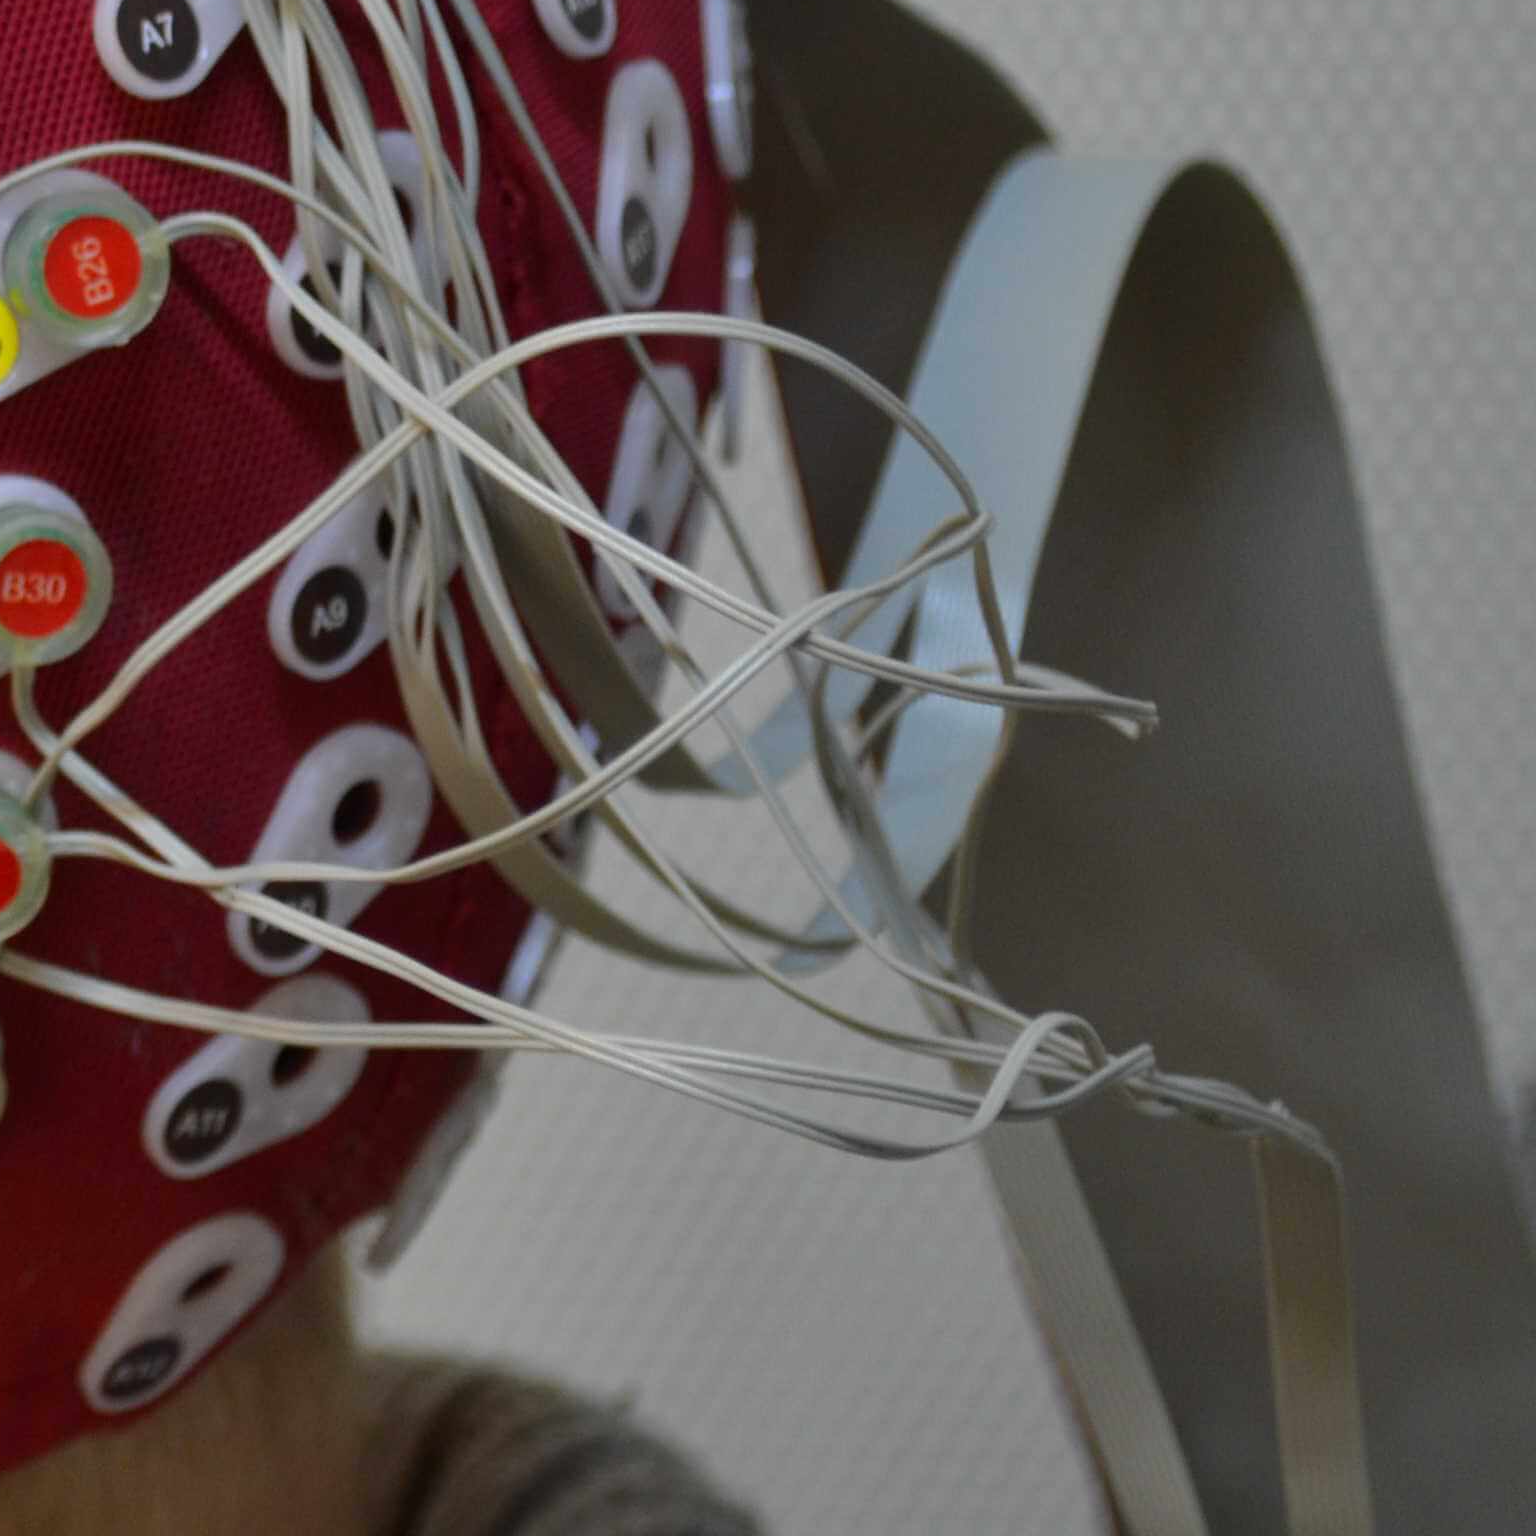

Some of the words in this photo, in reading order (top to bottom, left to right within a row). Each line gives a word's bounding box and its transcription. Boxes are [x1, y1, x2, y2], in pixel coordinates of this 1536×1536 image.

[140, 11, 173, 55] A7
[72, 235, 114, 307] B26
[0, 572, 67, 604] B30
[311, 595, 349, 638] A9
